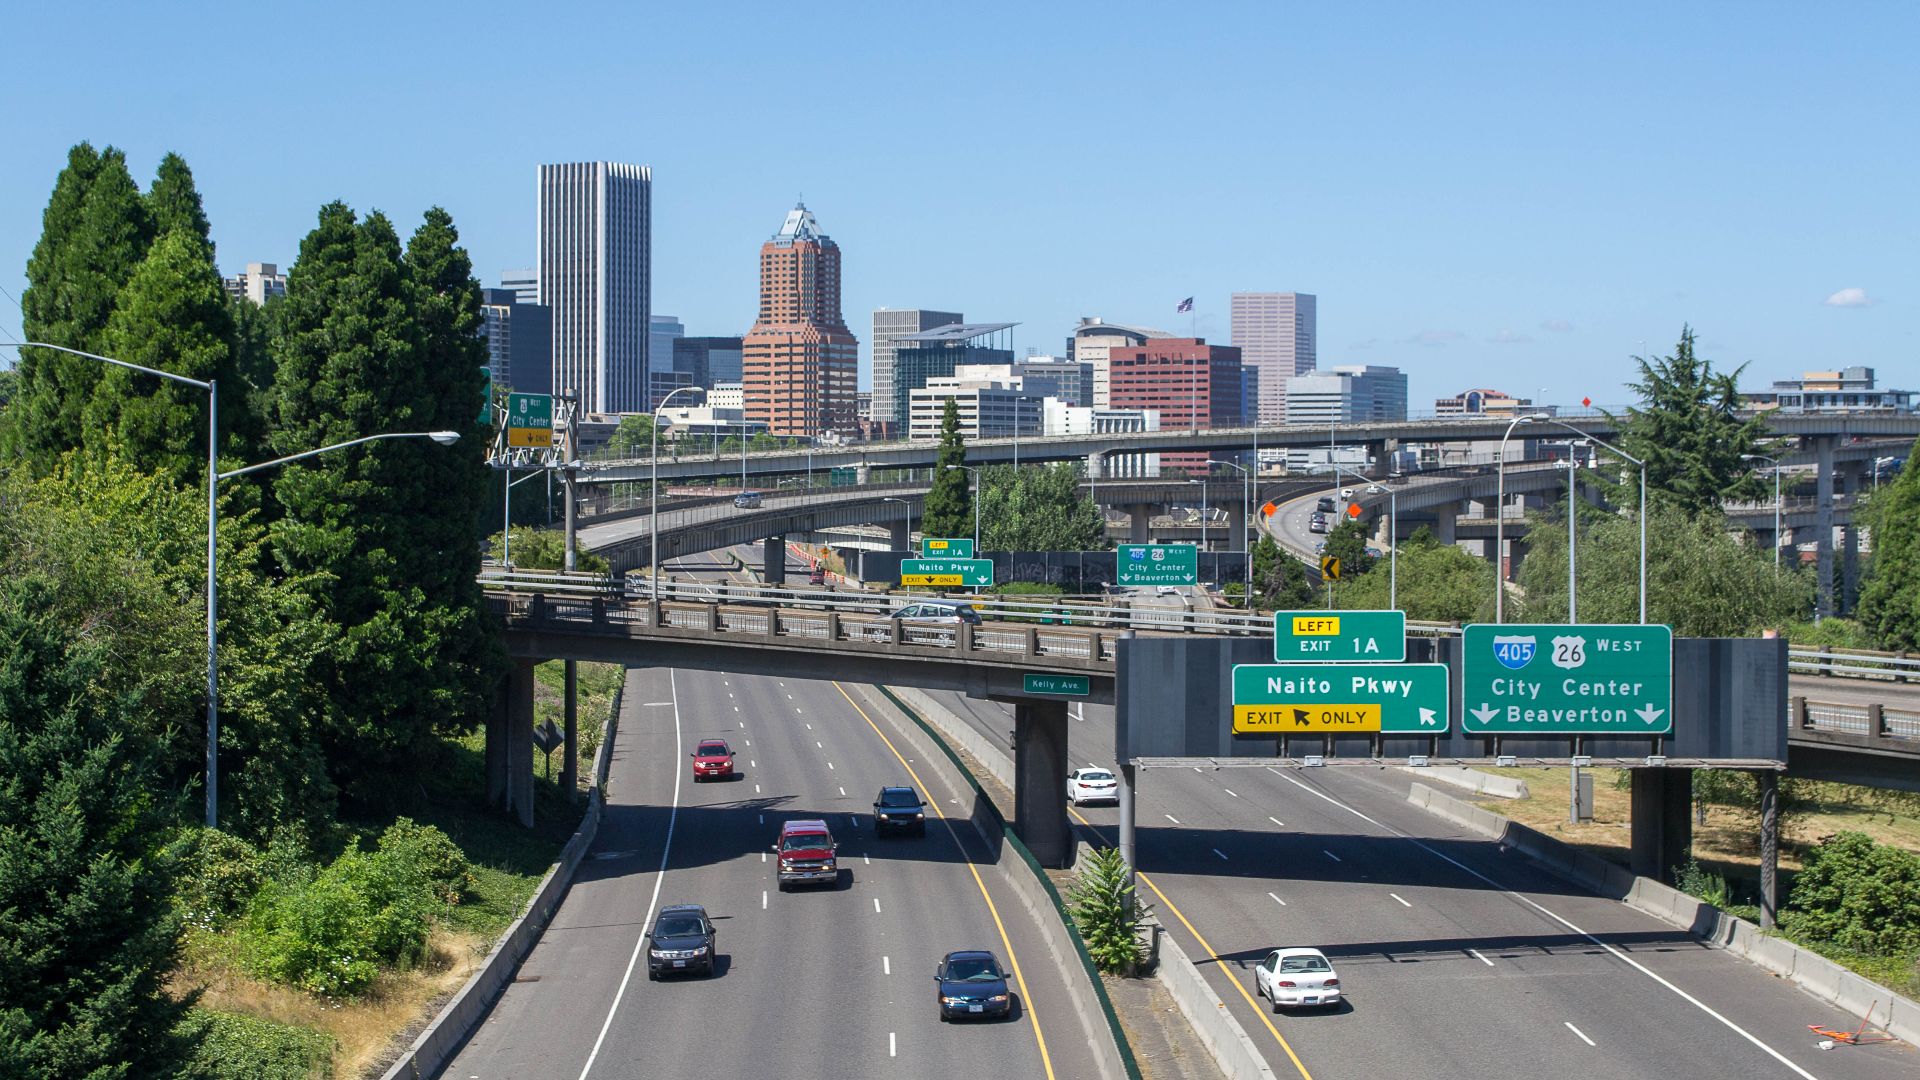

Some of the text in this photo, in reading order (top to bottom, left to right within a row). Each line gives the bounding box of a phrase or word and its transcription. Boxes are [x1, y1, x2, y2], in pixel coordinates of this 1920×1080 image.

[512, 416, 548, 427] City Center
[951, 564, 975, 572] Pkwy
[1128, 564, 1148, 572] City
[1298, 622, 1332, 631] LEFT
[1300, 638, 1379, 653] EXIT 1A
[1498, 638, 1642, 662] 405 26 WEST
[1032, 680, 1055, 690] Kelly
[1268, 677, 1412, 698] Naito Pkwy
[1492, 678, 1642, 700] City Center
[1247, 712, 1366, 724] EXIT ONLY
[1507, 706, 1627, 722] Beaverton
